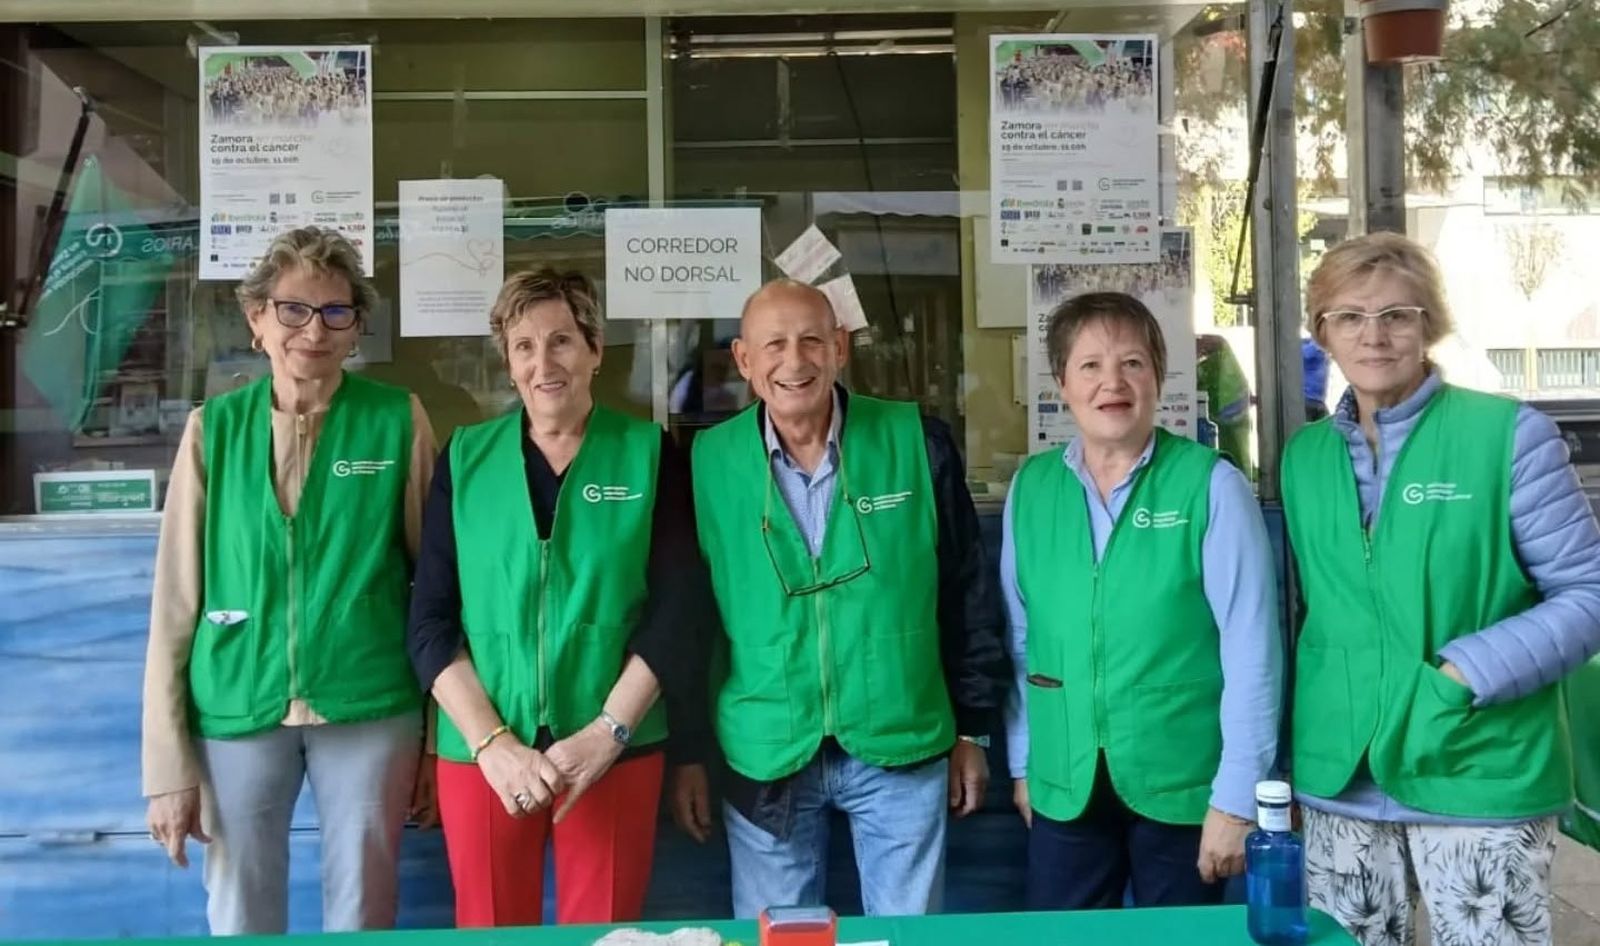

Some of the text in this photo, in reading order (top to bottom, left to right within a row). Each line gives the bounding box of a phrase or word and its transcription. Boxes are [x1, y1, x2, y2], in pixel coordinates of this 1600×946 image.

[1001, 121, 1042, 130] Zamora
[210, 134, 253, 144] Zamora
[1001, 130, 1036, 139] contra
[1039, 130, 1048, 139] el
[210, 143, 247, 153] contra
[249, 143, 261, 152] el
[1012, 143, 1023, 151] de
[626, 237, 739, 254] CORREDOR
[624, 265, 742, 282] NO DORSAL
